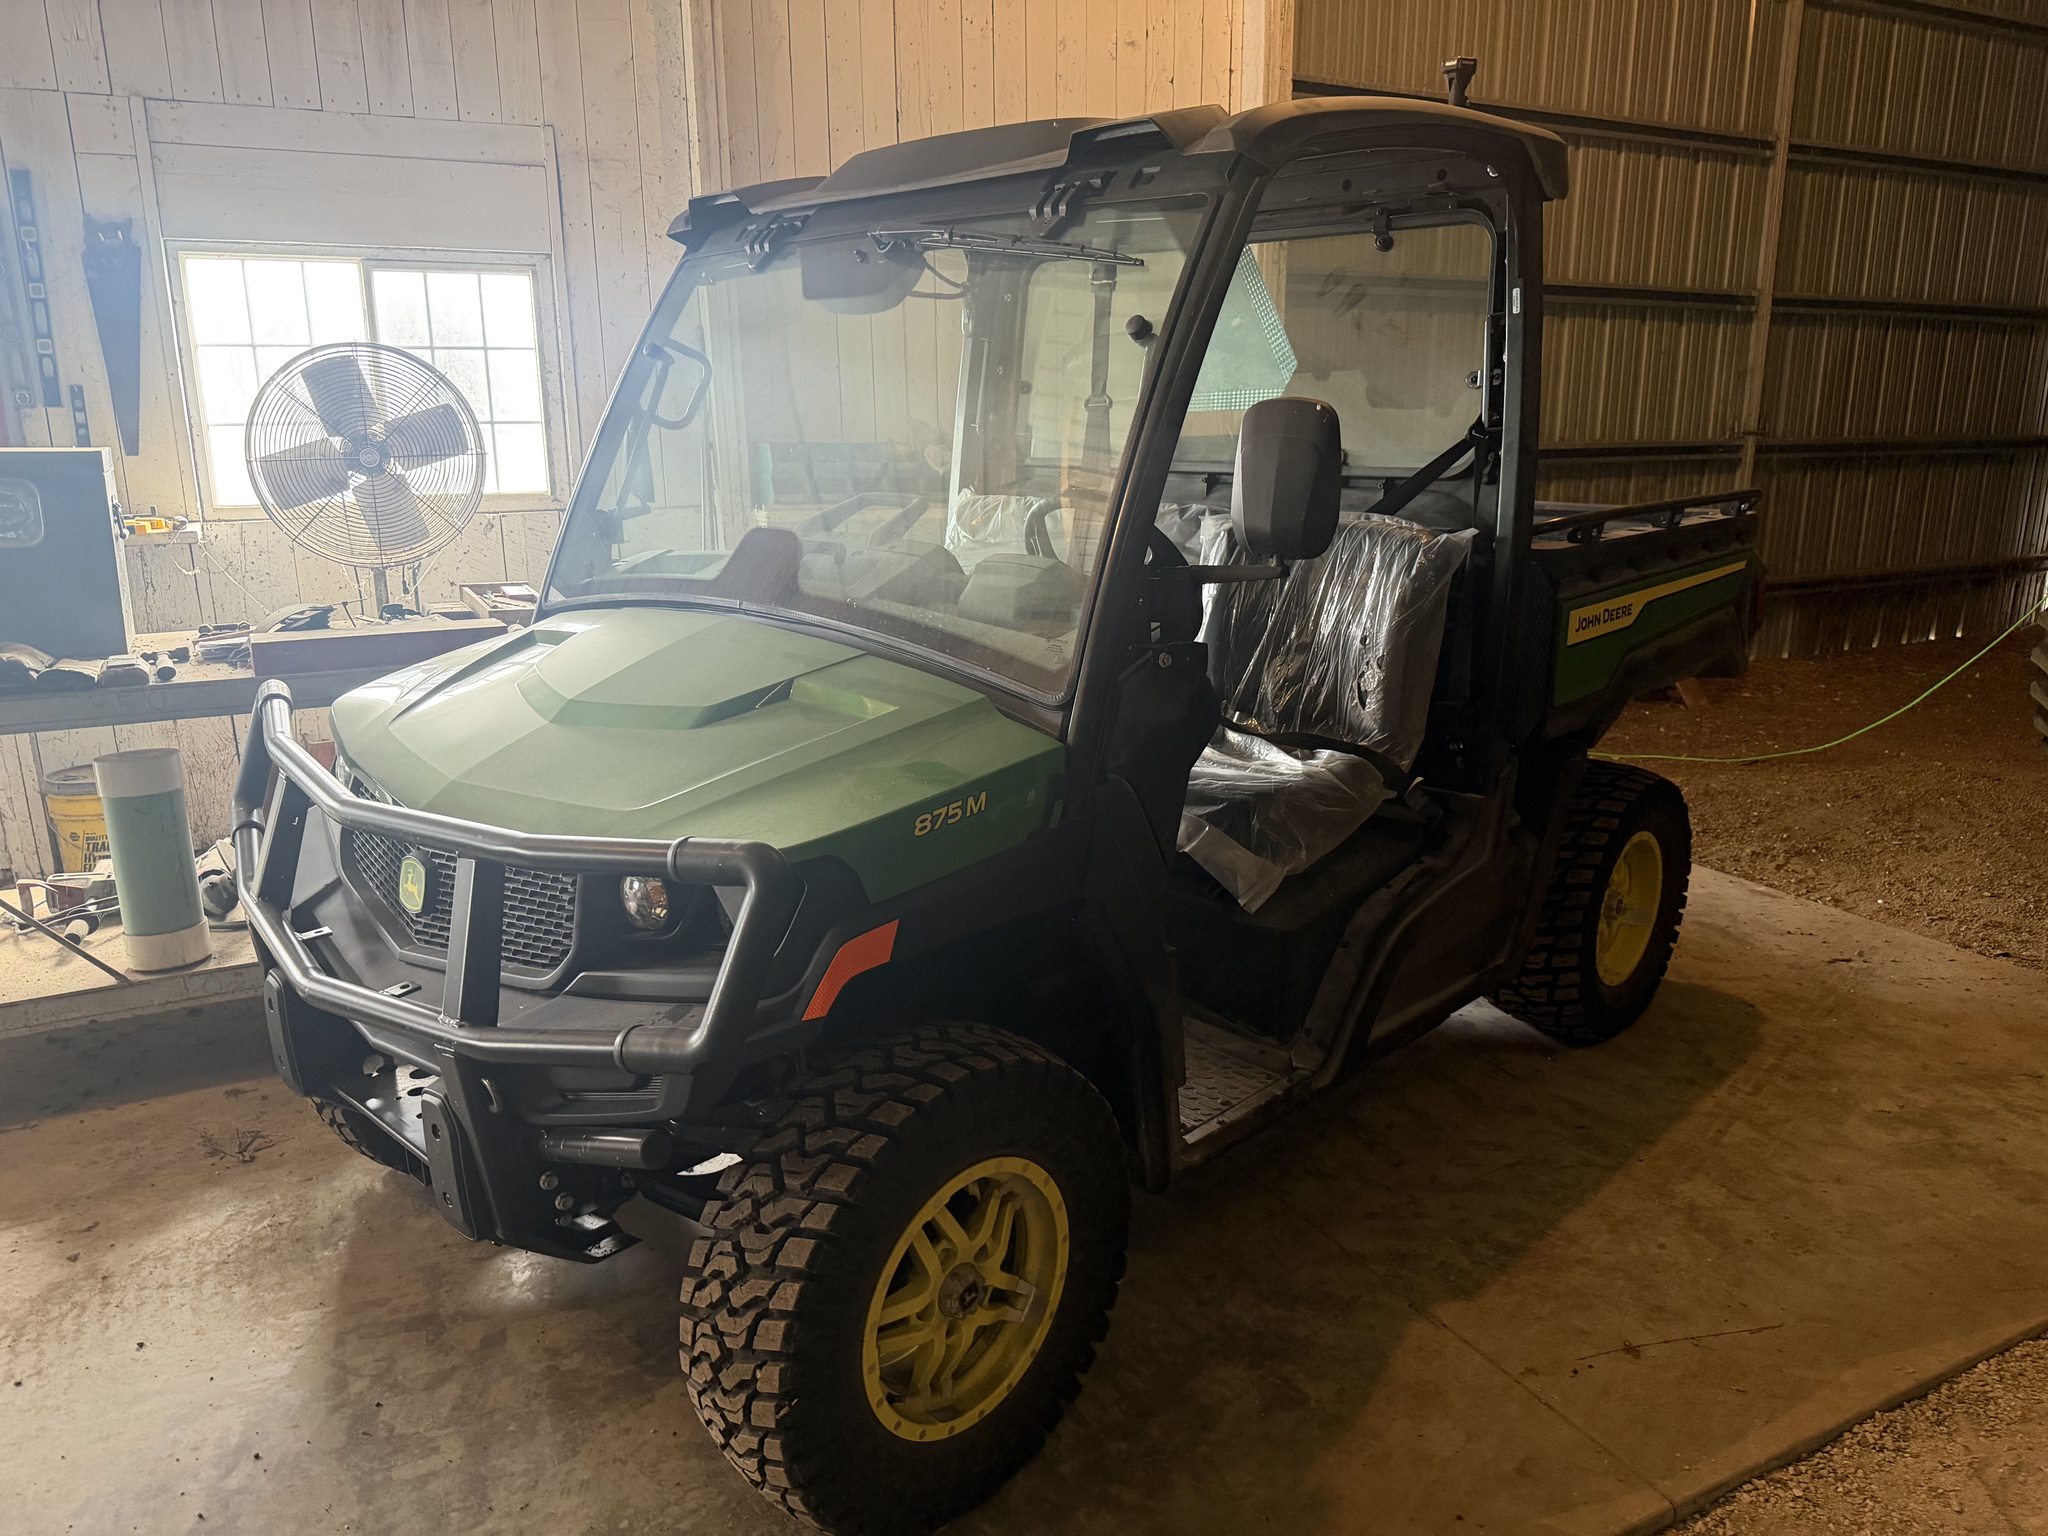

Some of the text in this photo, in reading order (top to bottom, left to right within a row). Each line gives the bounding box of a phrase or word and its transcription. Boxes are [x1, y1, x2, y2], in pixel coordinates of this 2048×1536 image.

[1575, 603, 1633, 633] JOHN DEERE
[914, 790, 987, 837] 875 M
